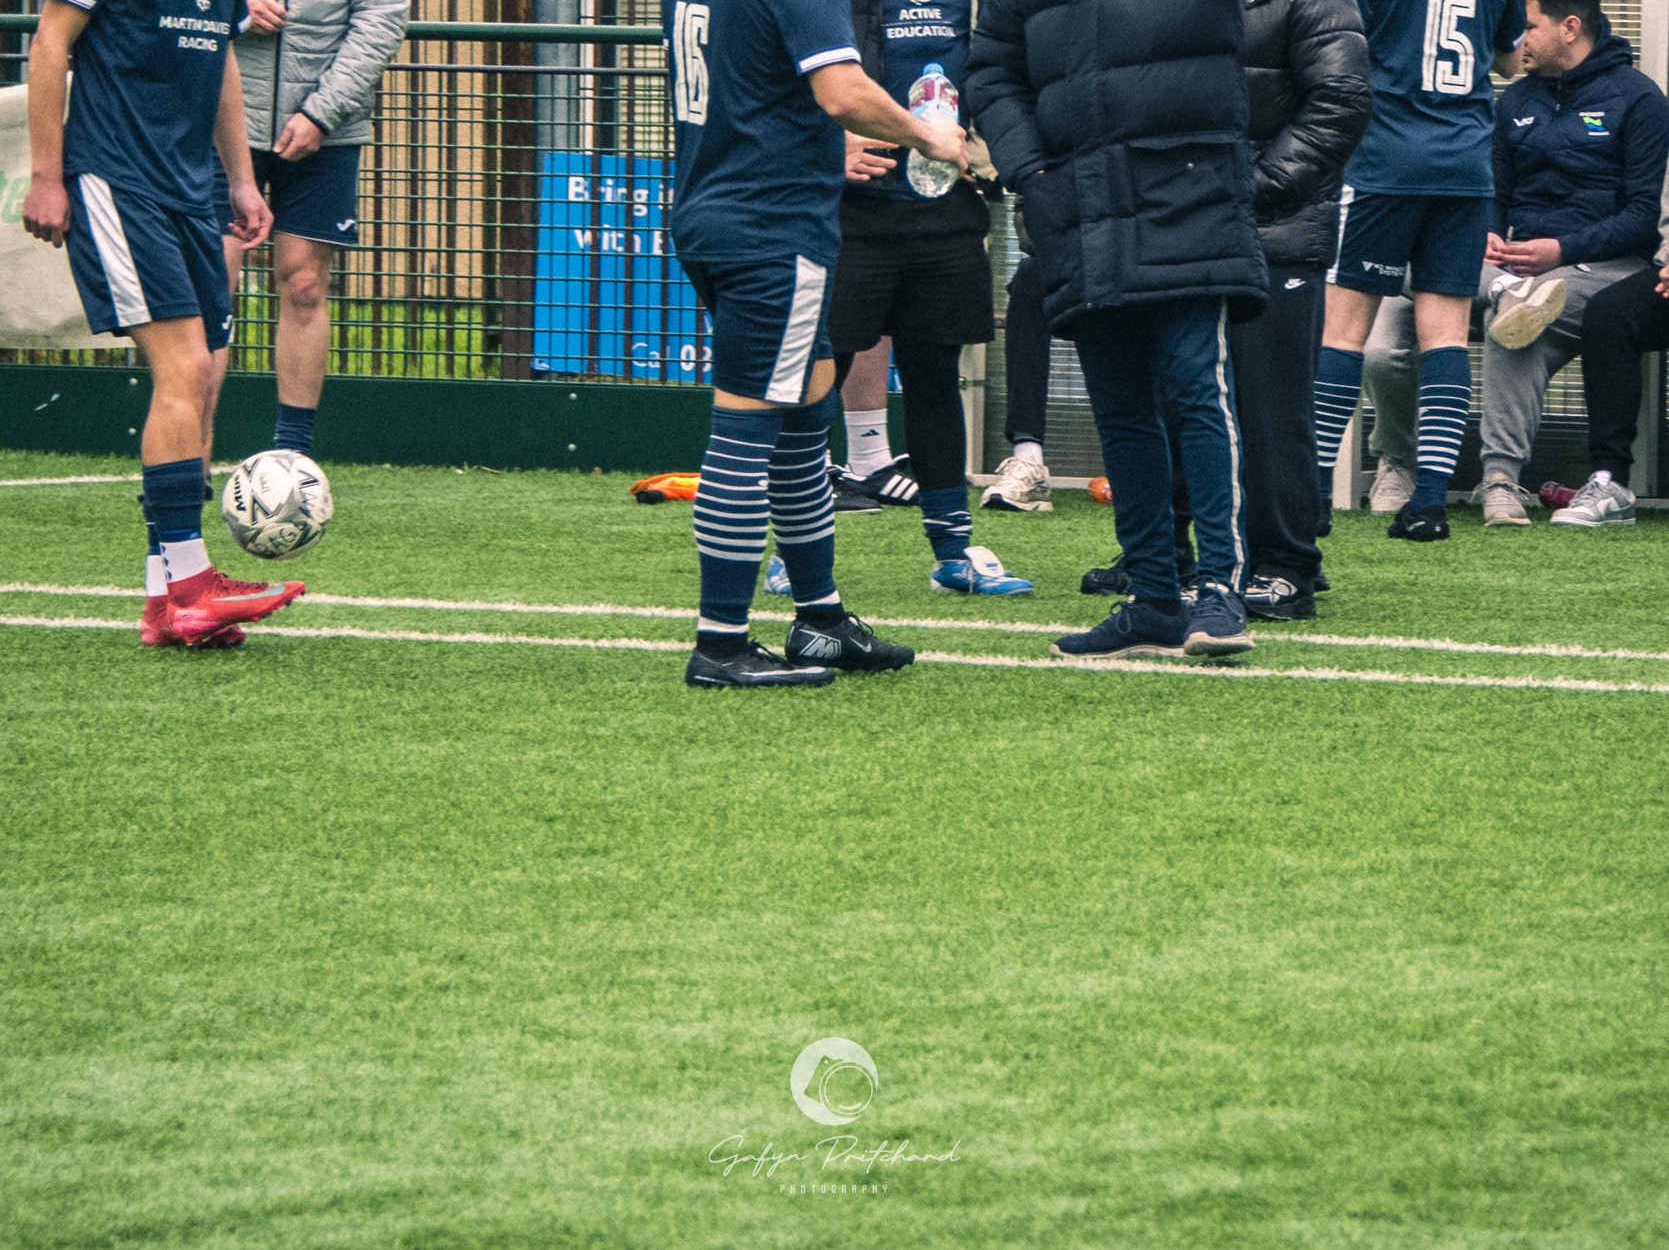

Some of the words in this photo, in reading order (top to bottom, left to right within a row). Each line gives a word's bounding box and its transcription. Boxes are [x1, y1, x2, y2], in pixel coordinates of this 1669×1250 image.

[899, 8, 942, 20] ACTIVE
[886, 25, 957, 39] EDUCATION
[672, 0, 710, 127] 16
